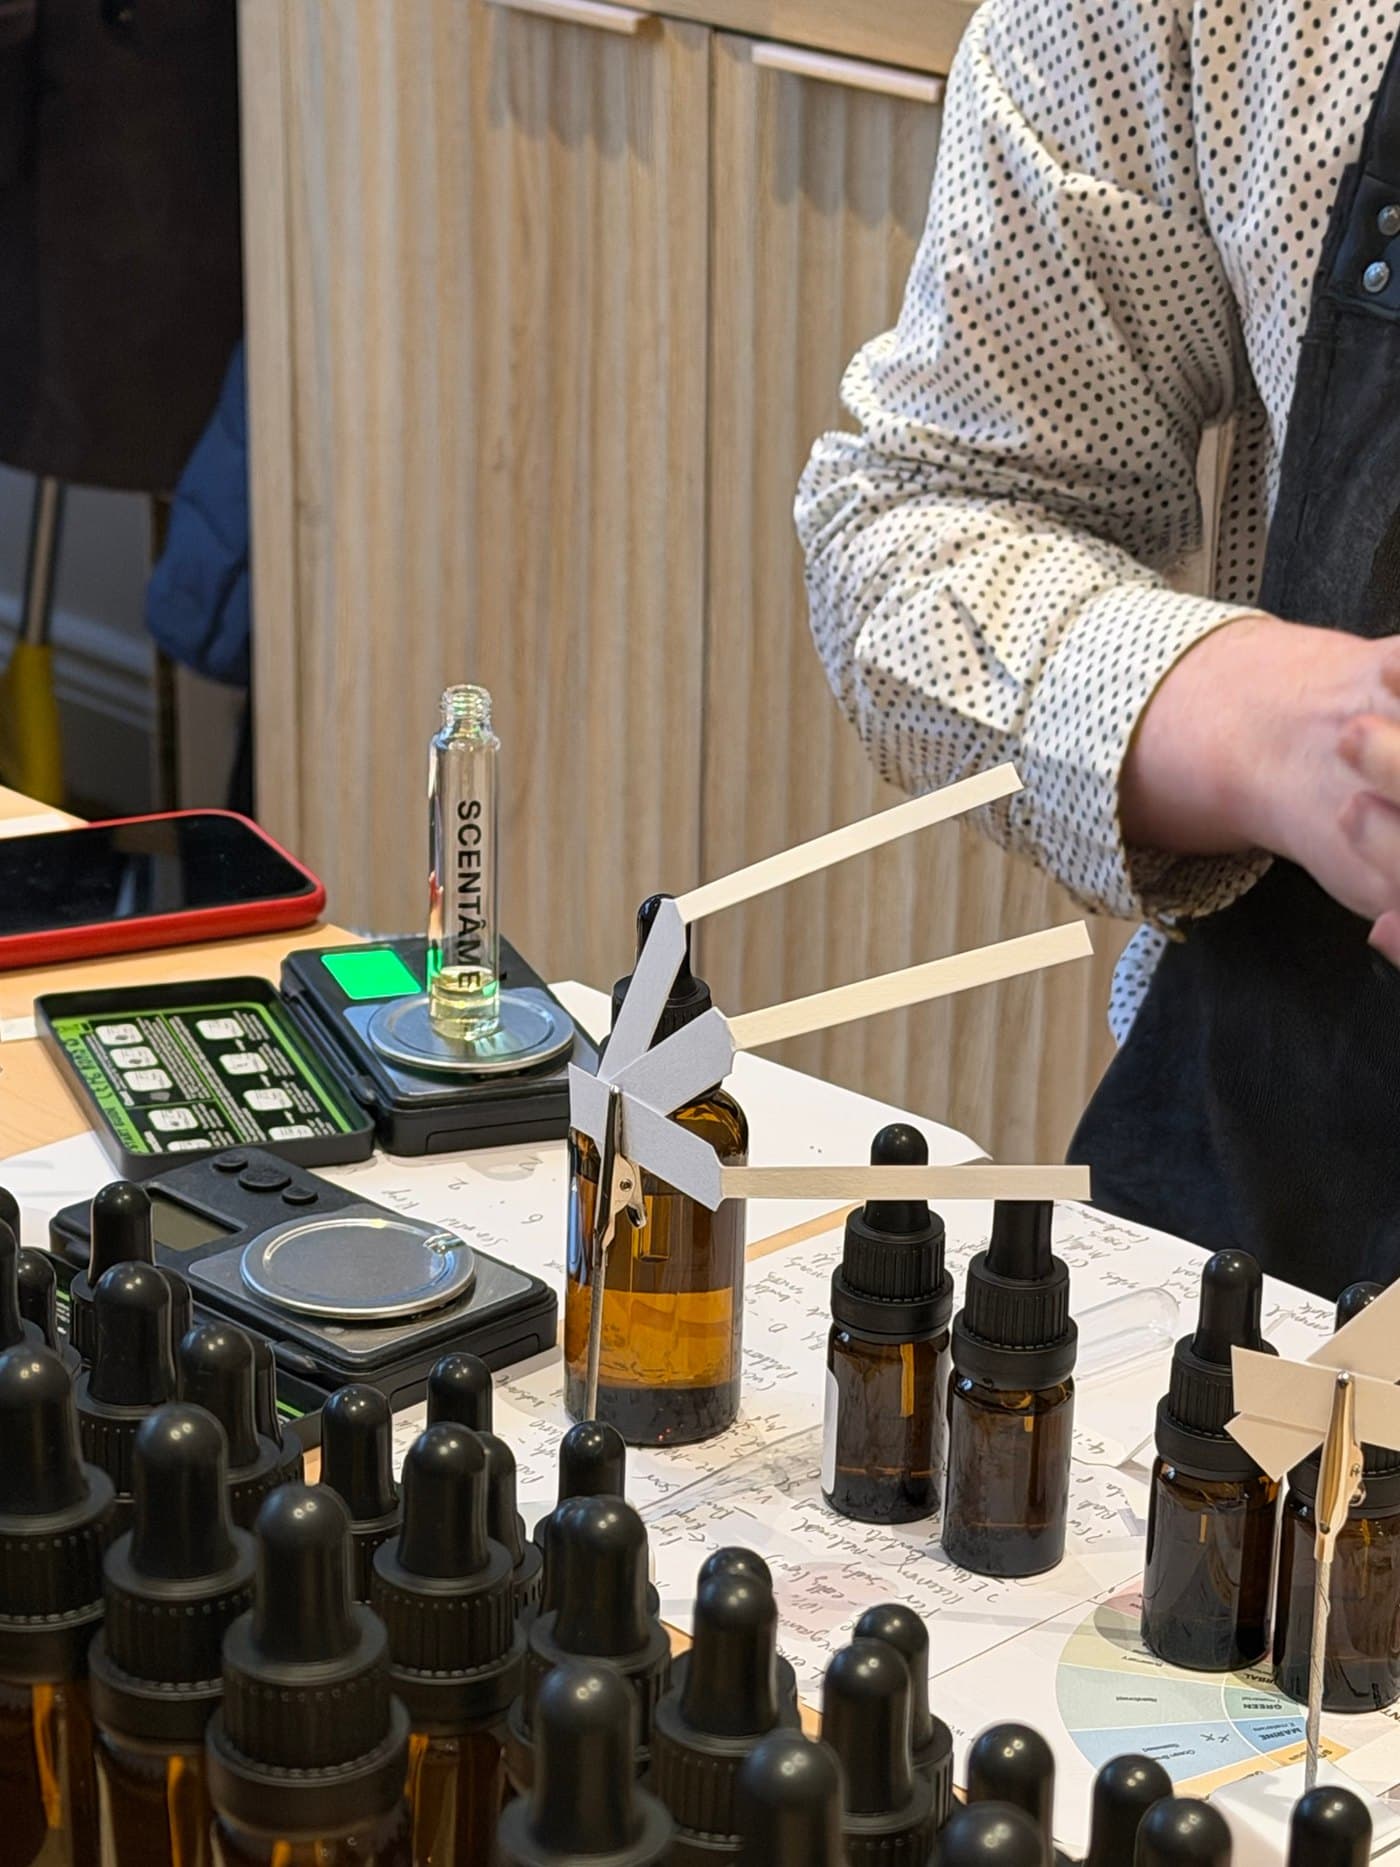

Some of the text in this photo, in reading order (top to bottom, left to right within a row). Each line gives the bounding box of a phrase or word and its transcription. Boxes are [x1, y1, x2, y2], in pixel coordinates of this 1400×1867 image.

[458, 800, 486, 988] SCENTÂME
[1243, 1703, 1282, 1711] GREEN
[1259, 1726, 1303, 1742] MARINE
